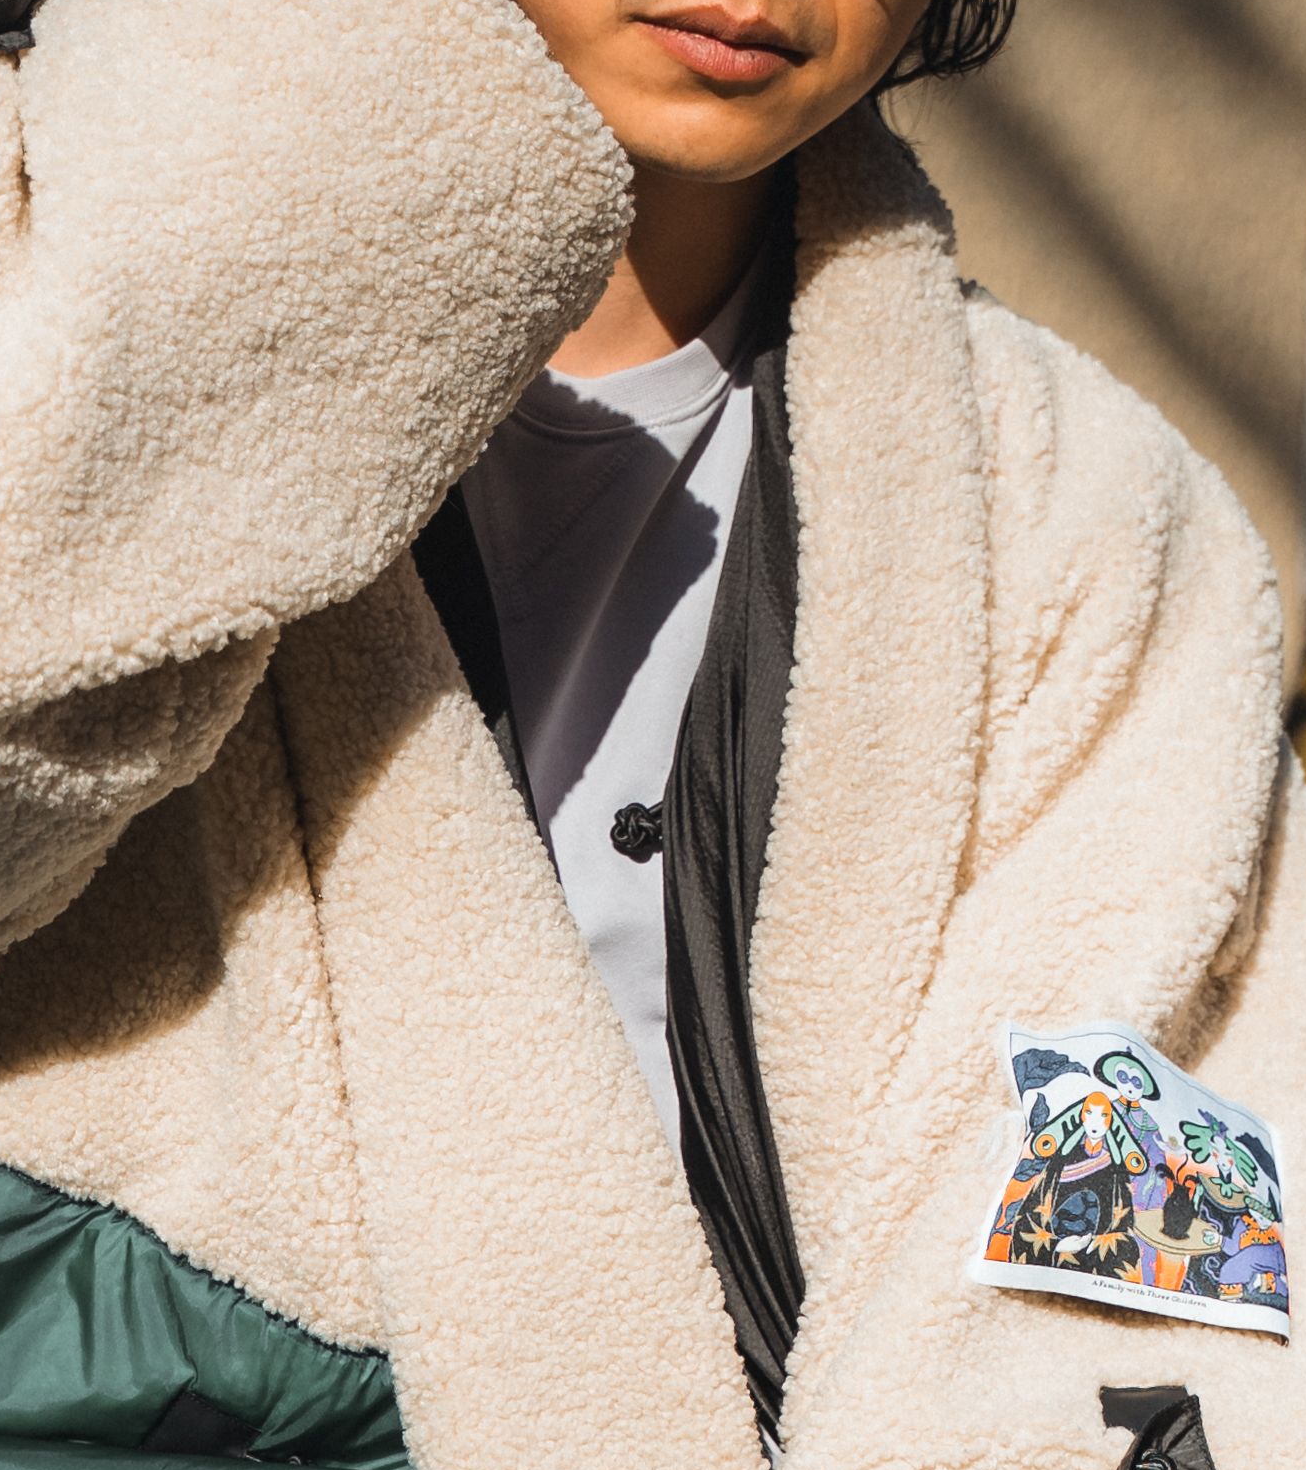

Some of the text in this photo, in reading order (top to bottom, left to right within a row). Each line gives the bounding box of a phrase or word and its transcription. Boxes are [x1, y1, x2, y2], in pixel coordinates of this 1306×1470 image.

[1099, 1280, 1125, 1293] Family
[1126, 1287, 1146, 1296] with
[1147, 1288, 1170, 1301] Three
[1171, 1295, 1207, 1308] Children
